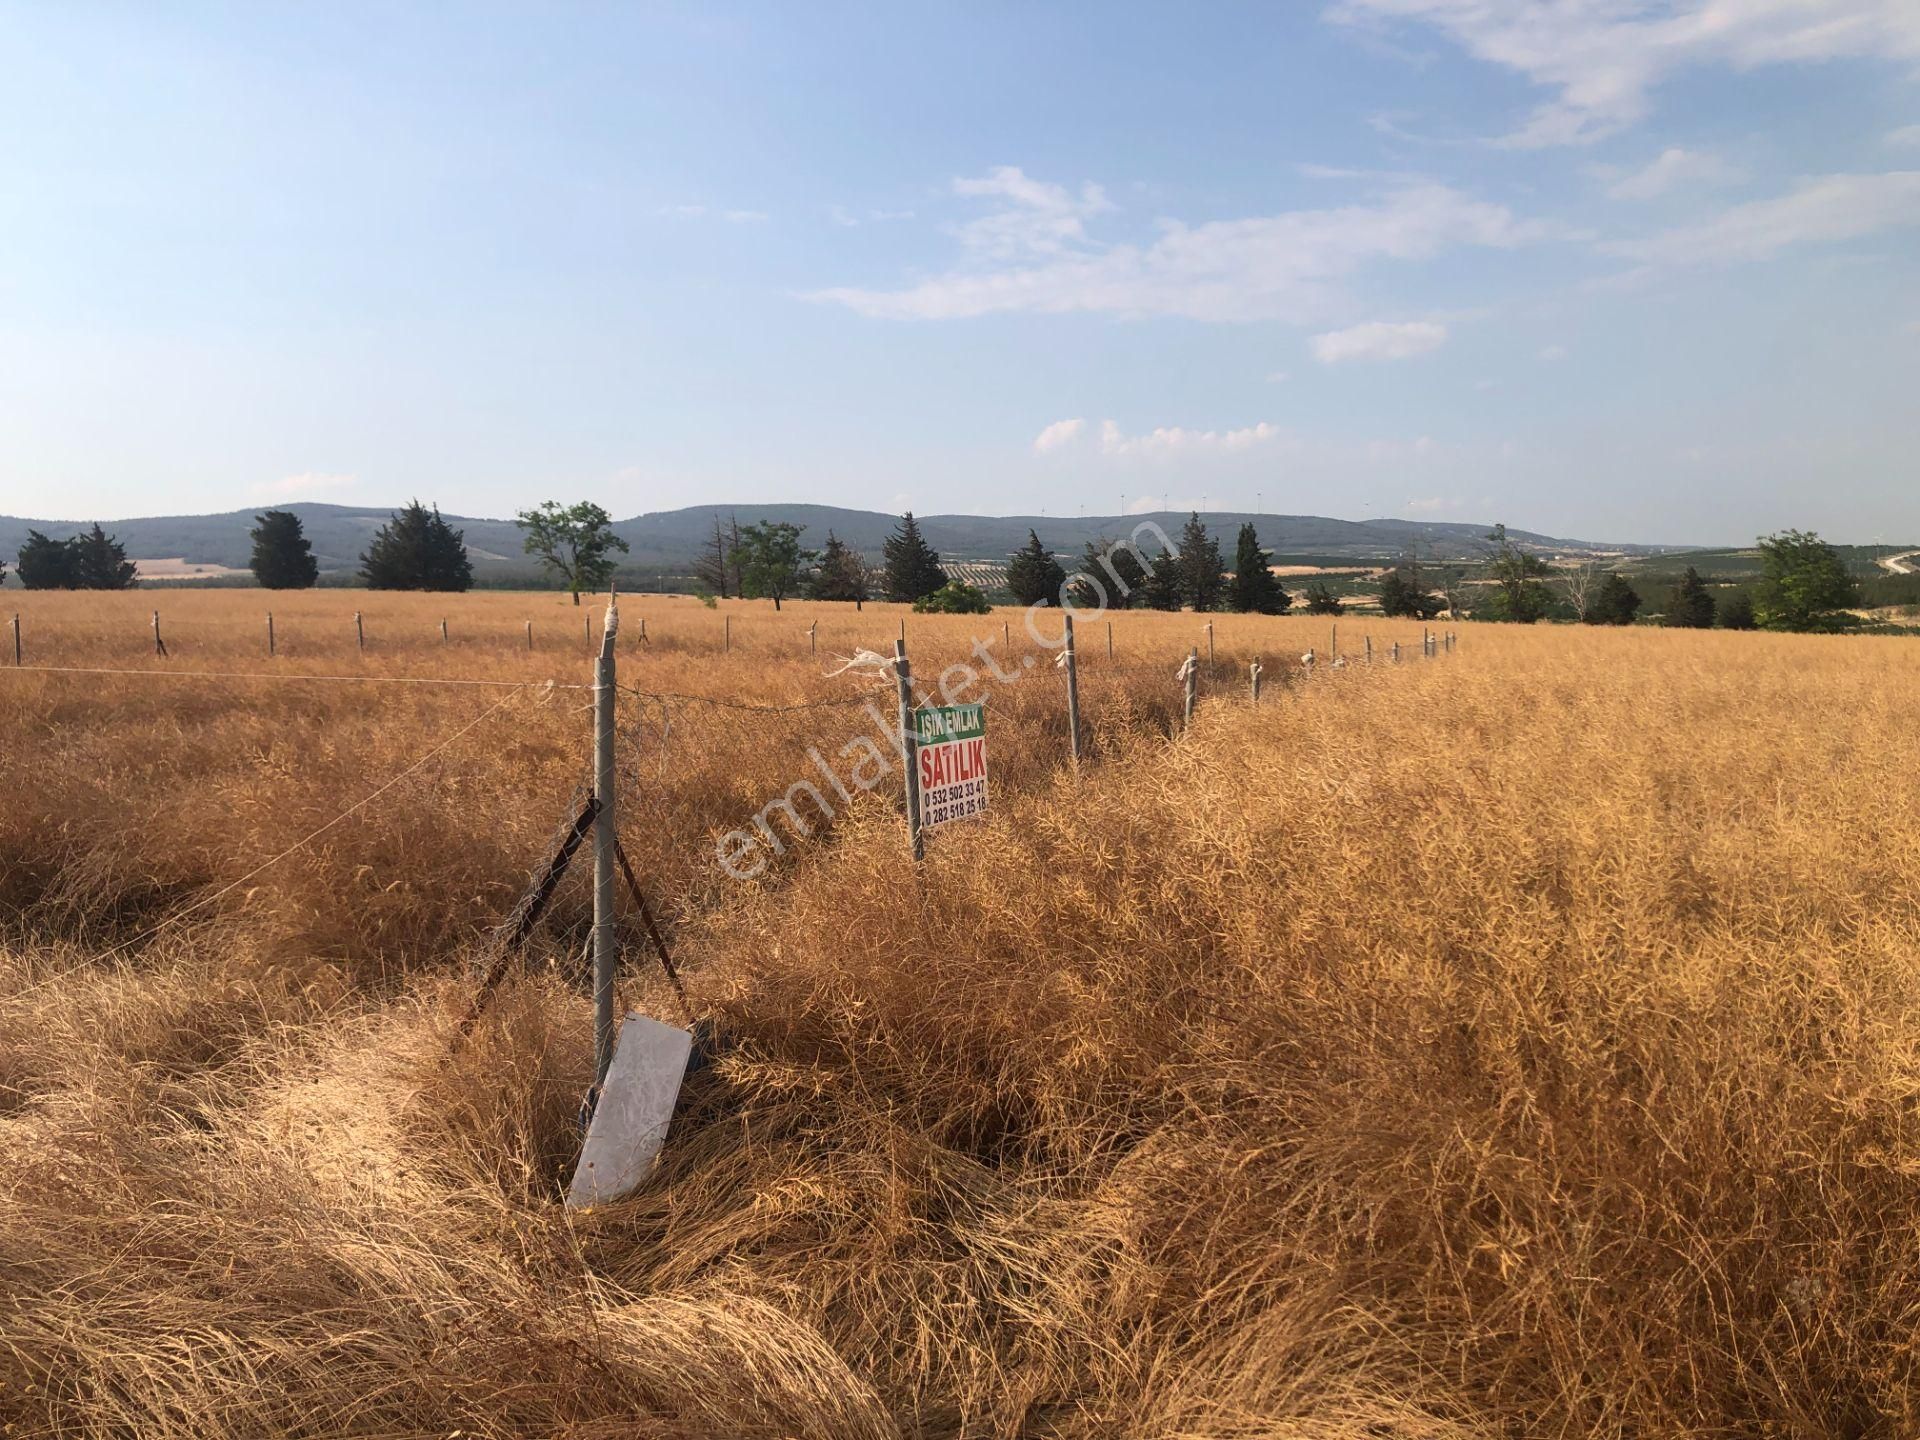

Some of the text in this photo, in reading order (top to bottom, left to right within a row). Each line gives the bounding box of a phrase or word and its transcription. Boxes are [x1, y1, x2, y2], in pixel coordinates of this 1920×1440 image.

[946, 709, 980, 734] EMLAK
[921, 740, 986, 789] SATILIK
[925, 780, 985, 808] 0 532 502 33 47
[926, 796, 986, 826] 0 282 518 25 18
